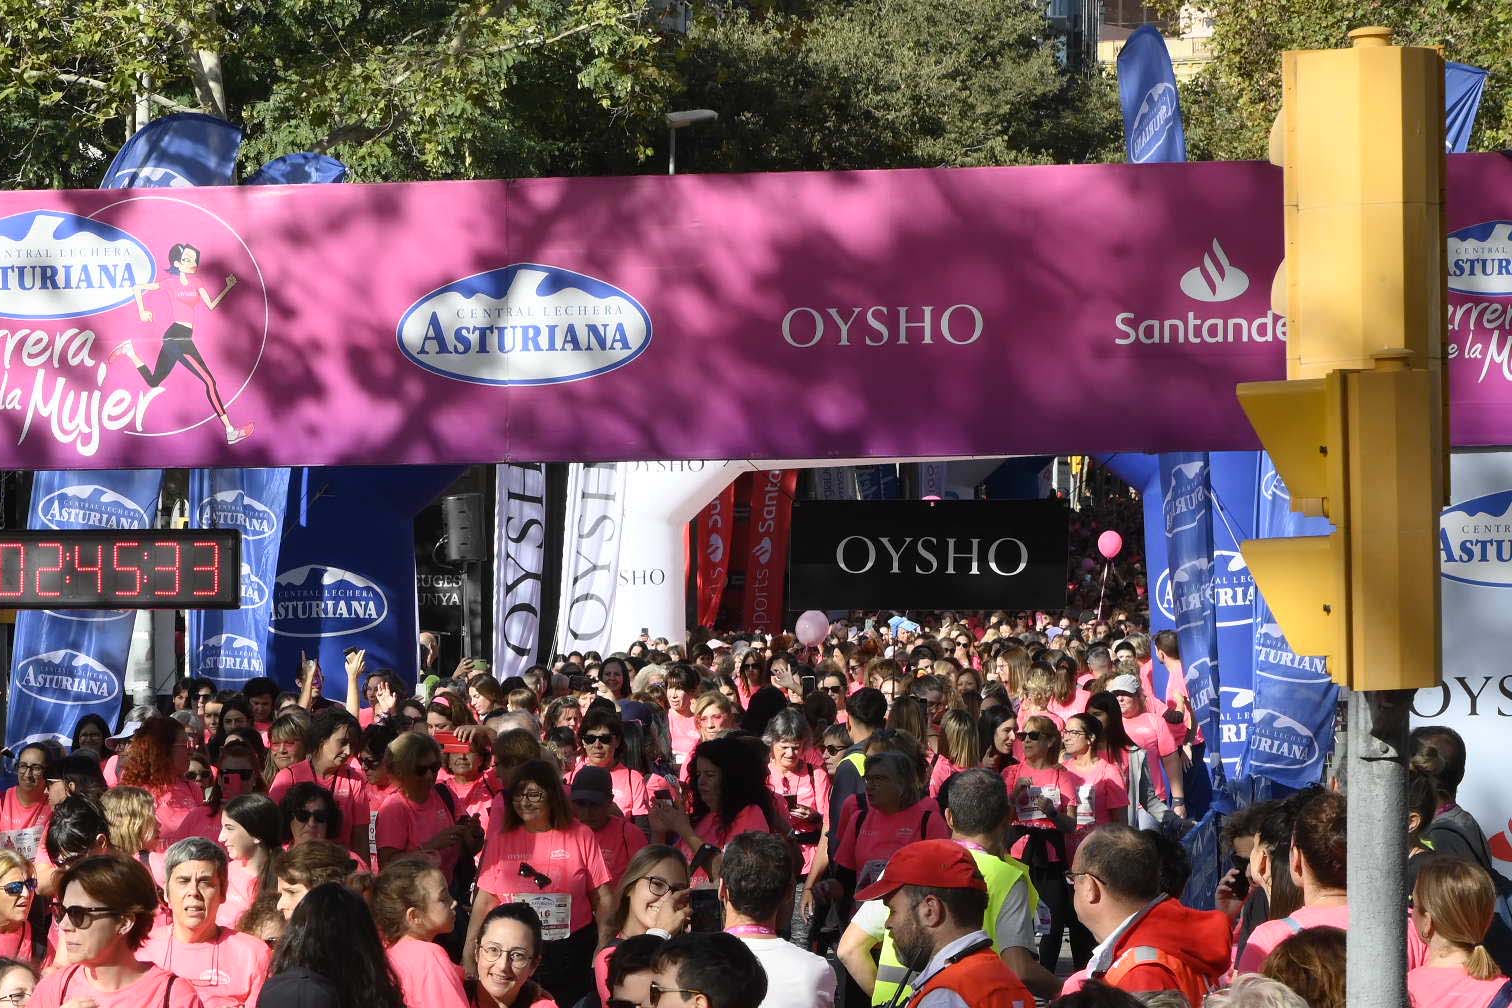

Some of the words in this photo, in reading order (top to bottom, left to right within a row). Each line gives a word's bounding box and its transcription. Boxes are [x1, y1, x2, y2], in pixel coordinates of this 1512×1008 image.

[60, 248, 131, 258] LECHERA
[456, 307, 534, 319] CENTRAL
[543, 304, 623, 316] LECHERA
[781, 304, 984, 348] OYSHO
[1114, 310, 1288, 345] Santande
[417, 311, 632, 355] ASTURIANA
[17, 362, 166, 457] Mujer
[46, 500, 139, 530] ASTURIANA
[502, 461, 545, 657] OYSH
[568, 461, 617, 641] OYSH
[836, 535, 1028, 576] OYSHO
[619, 569, 665, 585] SHO
[22, 664, 109, 697] ASTURIANA
